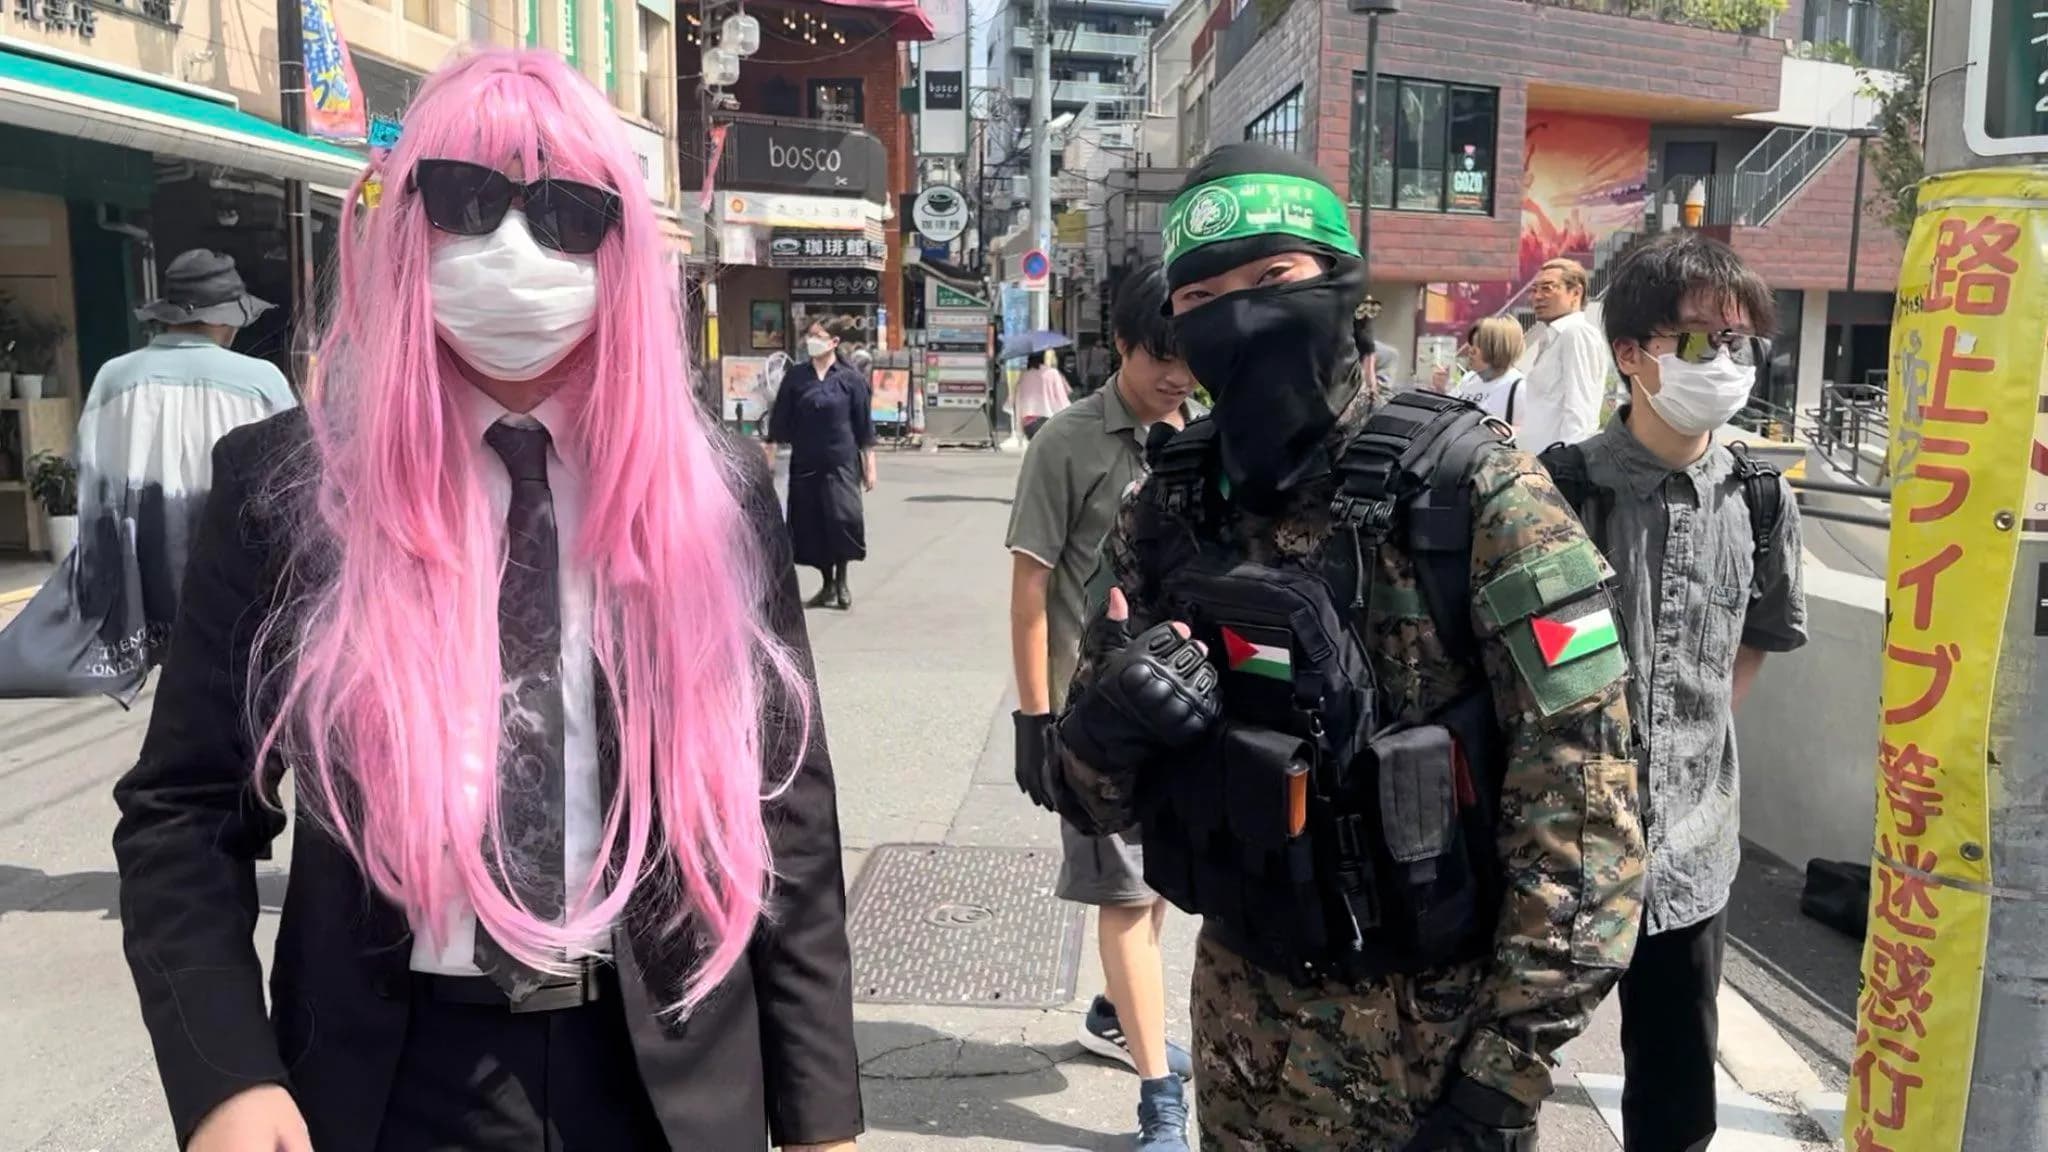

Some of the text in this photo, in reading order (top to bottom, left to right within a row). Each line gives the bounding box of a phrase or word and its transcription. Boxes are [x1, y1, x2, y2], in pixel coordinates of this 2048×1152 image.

[769, 137, 842, 172] bosco
[805, 238, 868, 256] 珈琲館
